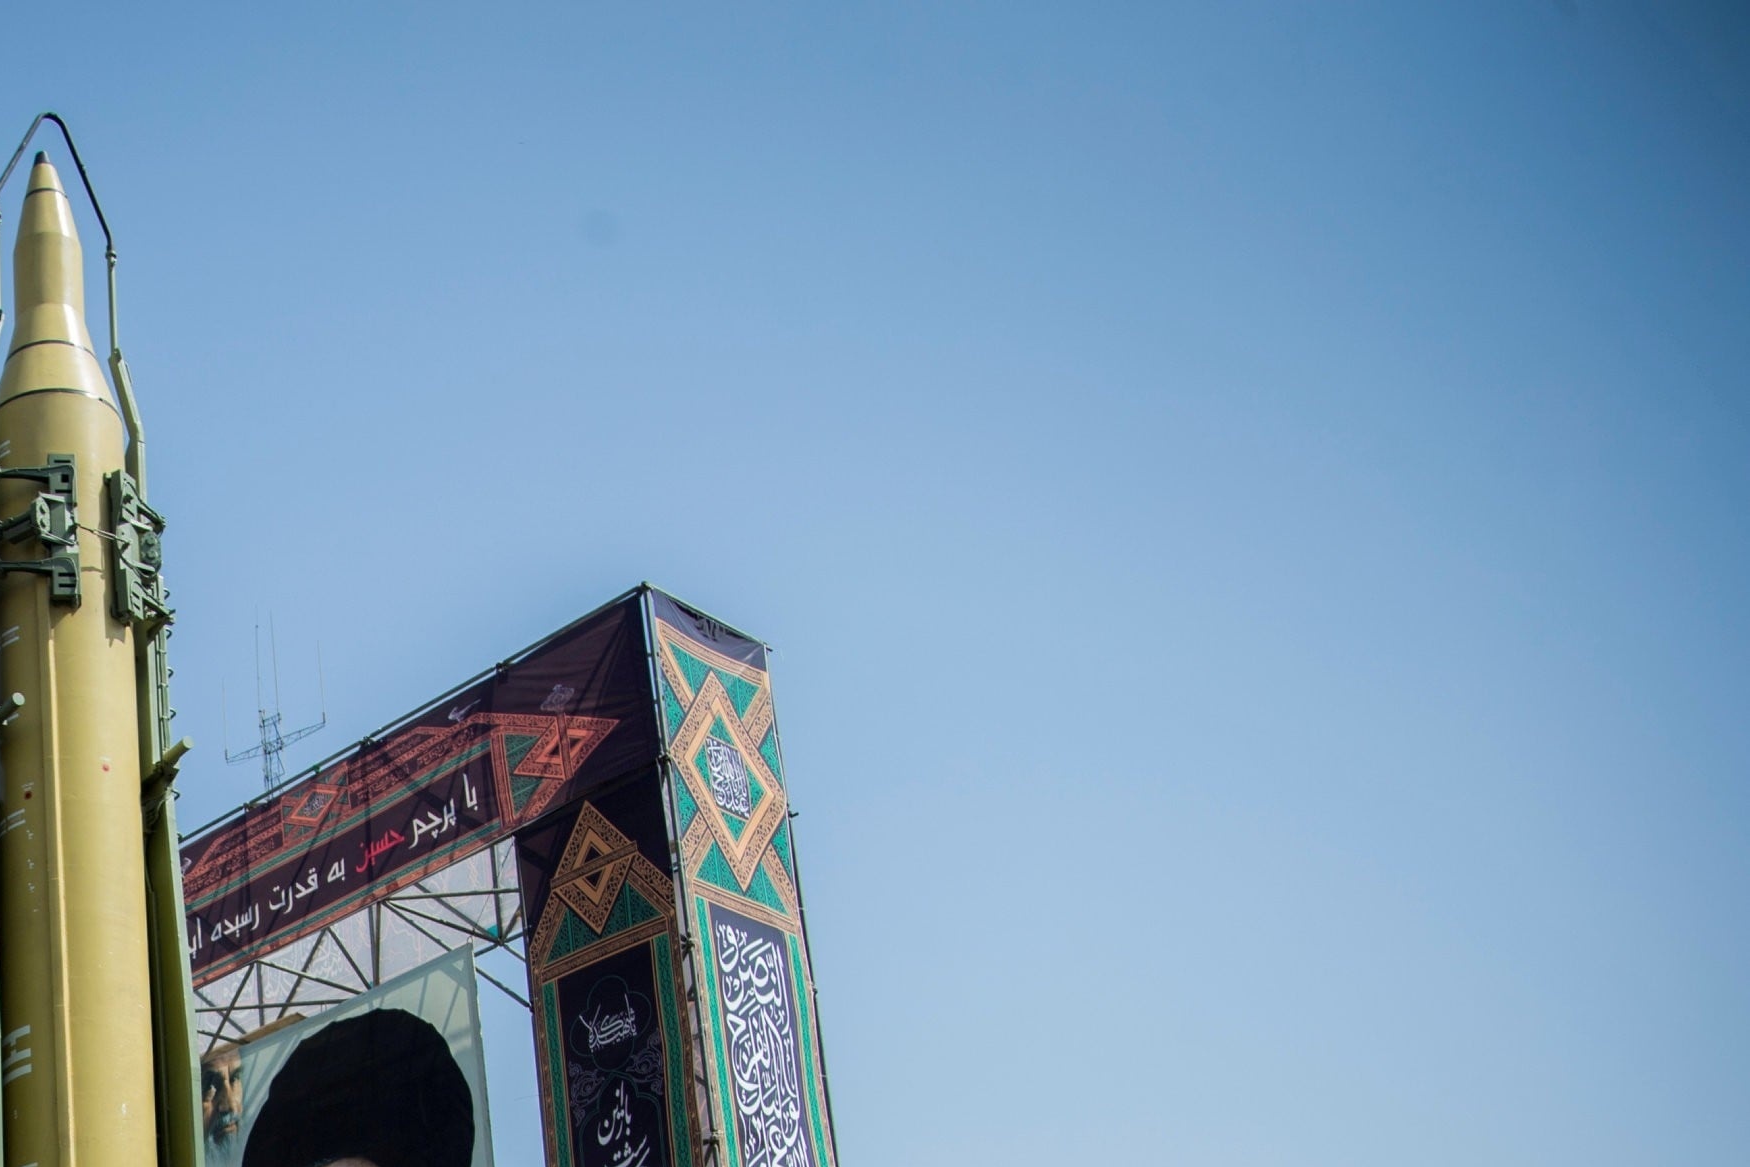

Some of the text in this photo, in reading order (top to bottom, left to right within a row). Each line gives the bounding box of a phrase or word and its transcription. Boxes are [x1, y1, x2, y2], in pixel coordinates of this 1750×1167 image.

[462, 774, 478, 810] با
[409, 799, 455, 849] پرچم
[327, 858, 345, 881] به
[355, 828, 405, 872] حسین
[269, 866, 318, 913] قدرت
[211, 904, 260, 940] رسیده
